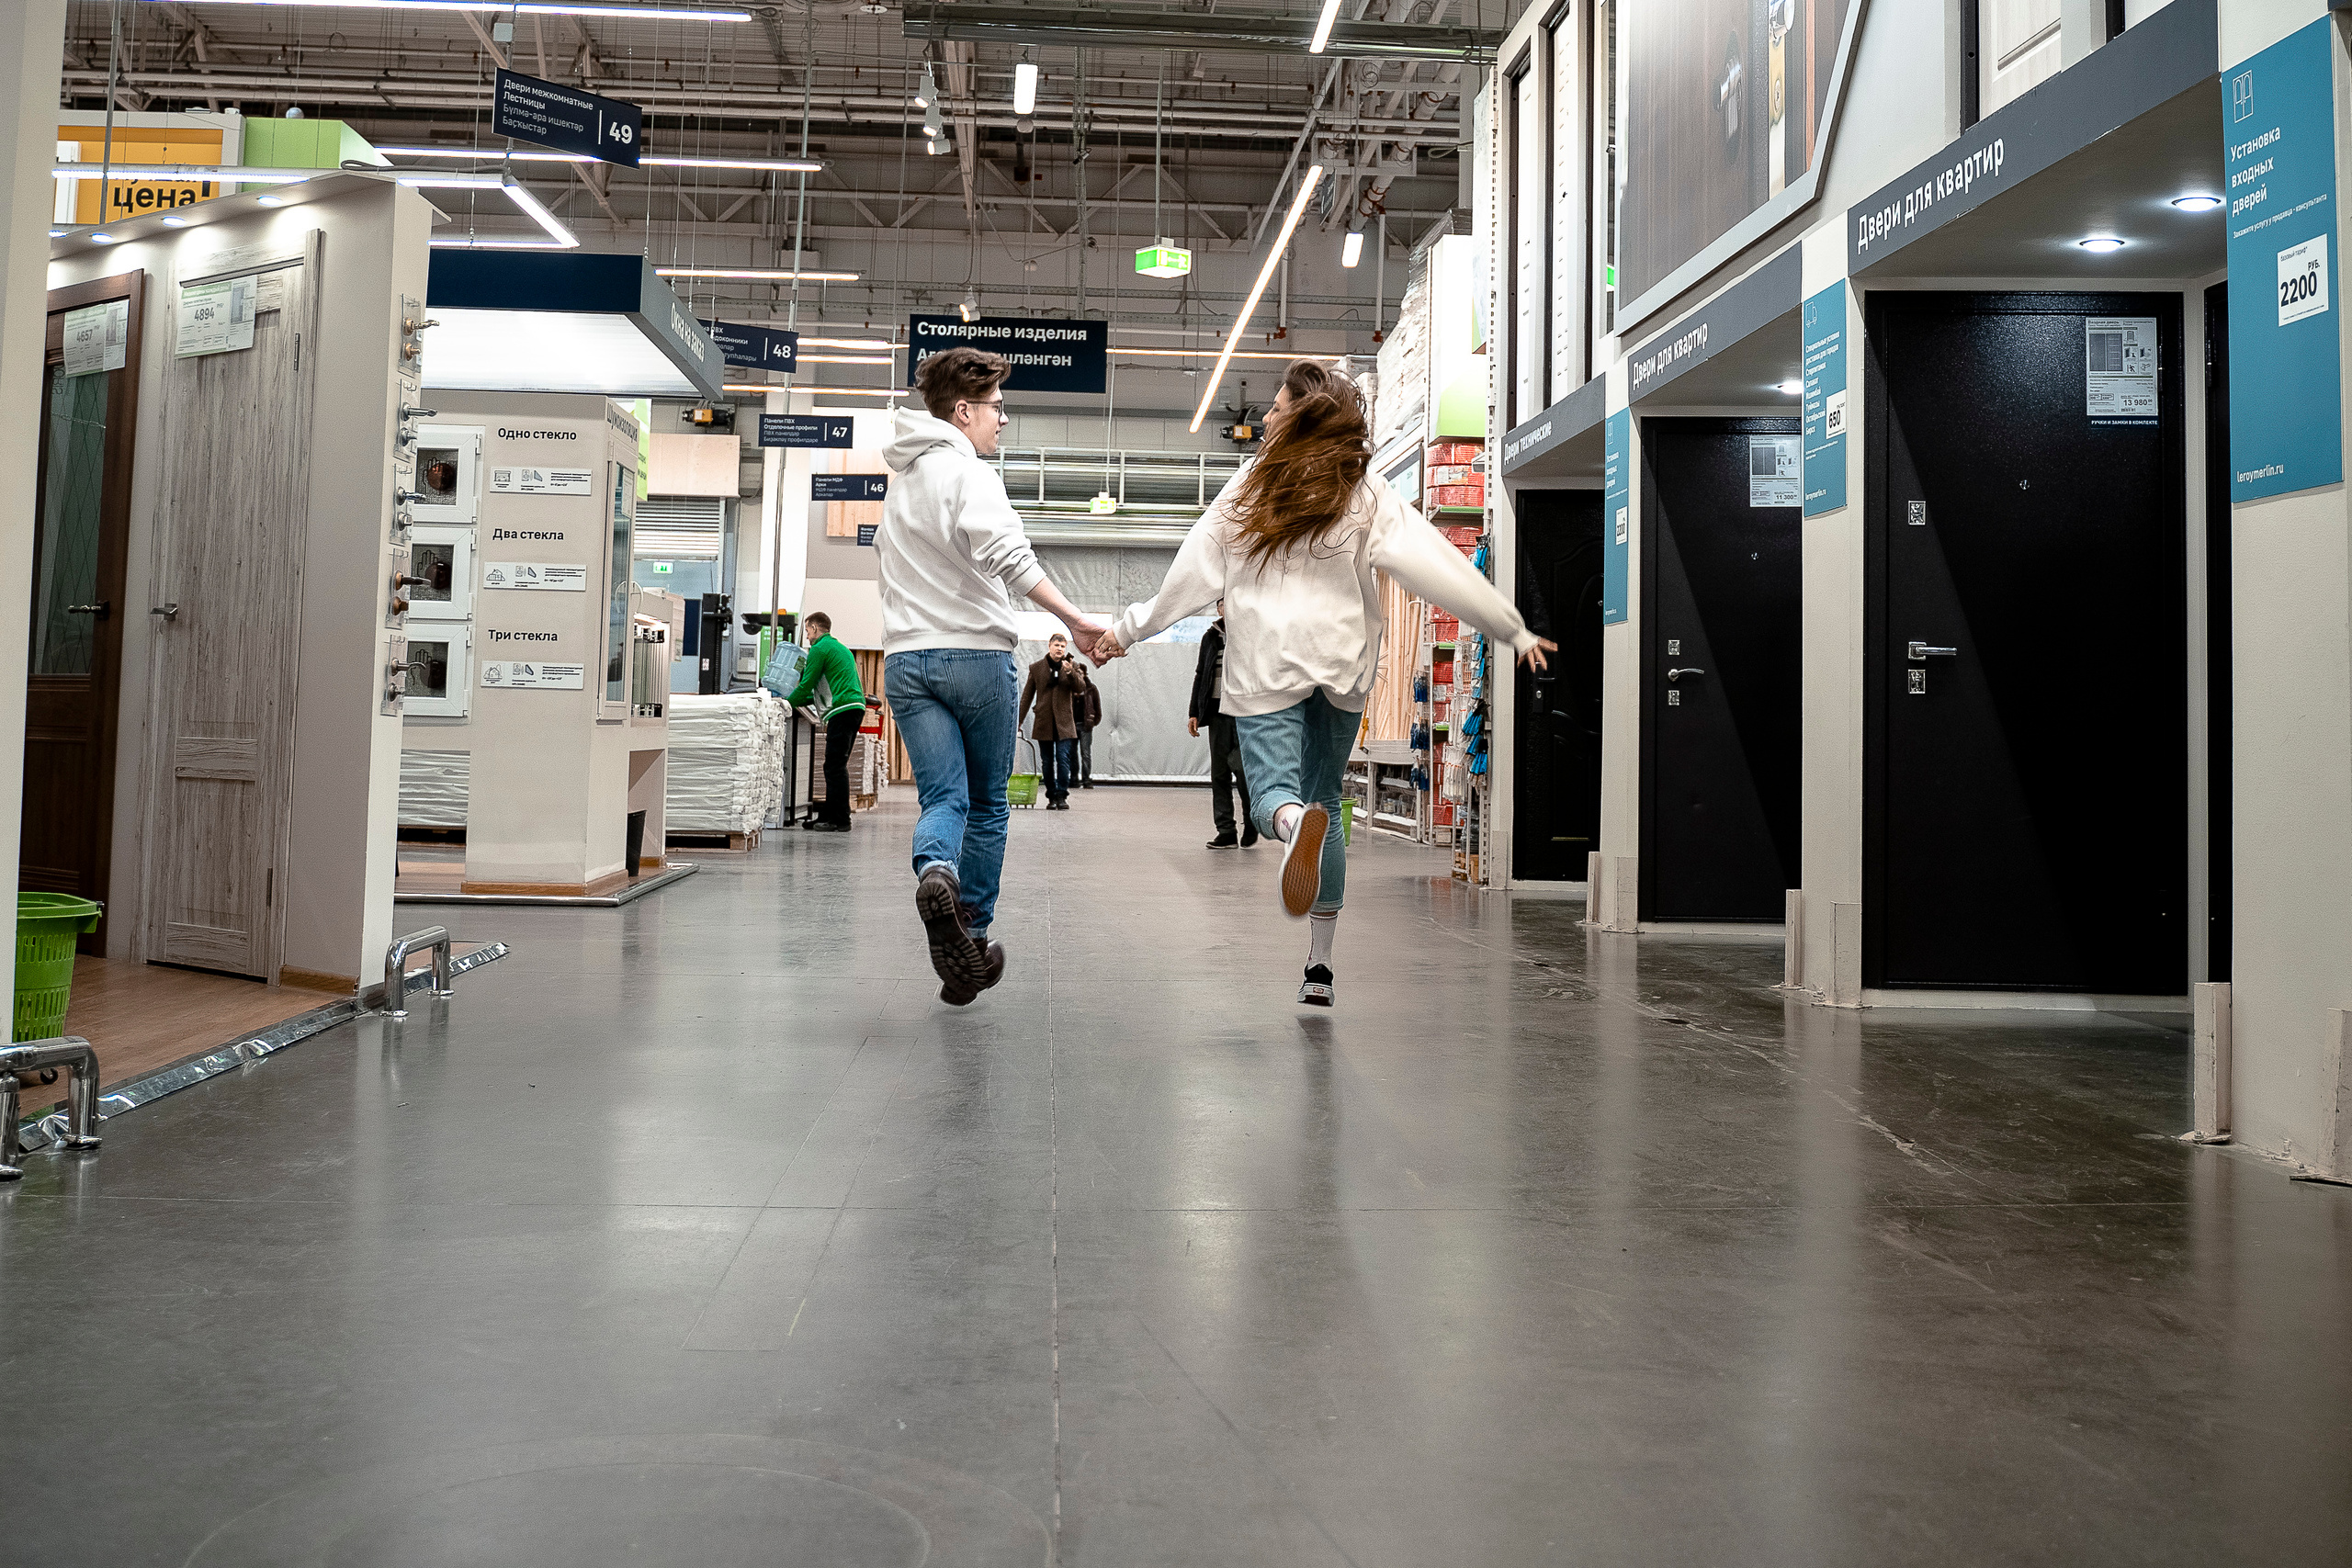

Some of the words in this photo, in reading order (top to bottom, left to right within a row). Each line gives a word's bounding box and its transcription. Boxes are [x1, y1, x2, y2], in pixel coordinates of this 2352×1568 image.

[503, 79, 530, 93] Двери
[531, 87, 594, 110] межкомнатные
[503, 91, 546, 110] Лестницы
[609, 121, 633, 144] 49
[2230, 127, 2281, 163] Установка
[2231, 157, 2275, 188] входных
[1857, 199, 1901, 255] Двери
[1904, 181, 1933, 228] для
[1936, 138, 2005, 202] квартир
[2232, 184, 2268, 218] дверей
[2307, 259, 2321, 271] РУБ.
[2279, 271, 2318, 308] 2200
[194, 307, 215, 321] 4894
[76, 329, 93, 343] 4657
[671, 301, 684, 339] Окна
[684, 321, 691, 348] на
[691, 333, 706, 363] заказ
[917, 321, 1012, 340] Столярные
[1014, 327, 1088, 342] изделия
[773, 344, 791, 358] 48
[1633, 355, 1656, 391] Двери
[1657, 344, 1672, 377] для
[1673, 322, 1708, 361] квартир
[1828, 409, 1841, 429] 650
[497, 428, 531, 441] Одно
[533, 430, 577, 441] стекло
[831, 426, 848, 438] 47
[1503, 439, 1520, 466] Двери
[1520, 420, 1553, 453] технические
[2236, 464, 2284, 483] leroymerlin.ru
[870, 483, 885, 492] 46
[492, 528, 518, 541] Два
[520, 530, 564, 540] стекла
[488, 629, 512, 642] Три
[514, 631, 558, 642] стекла
